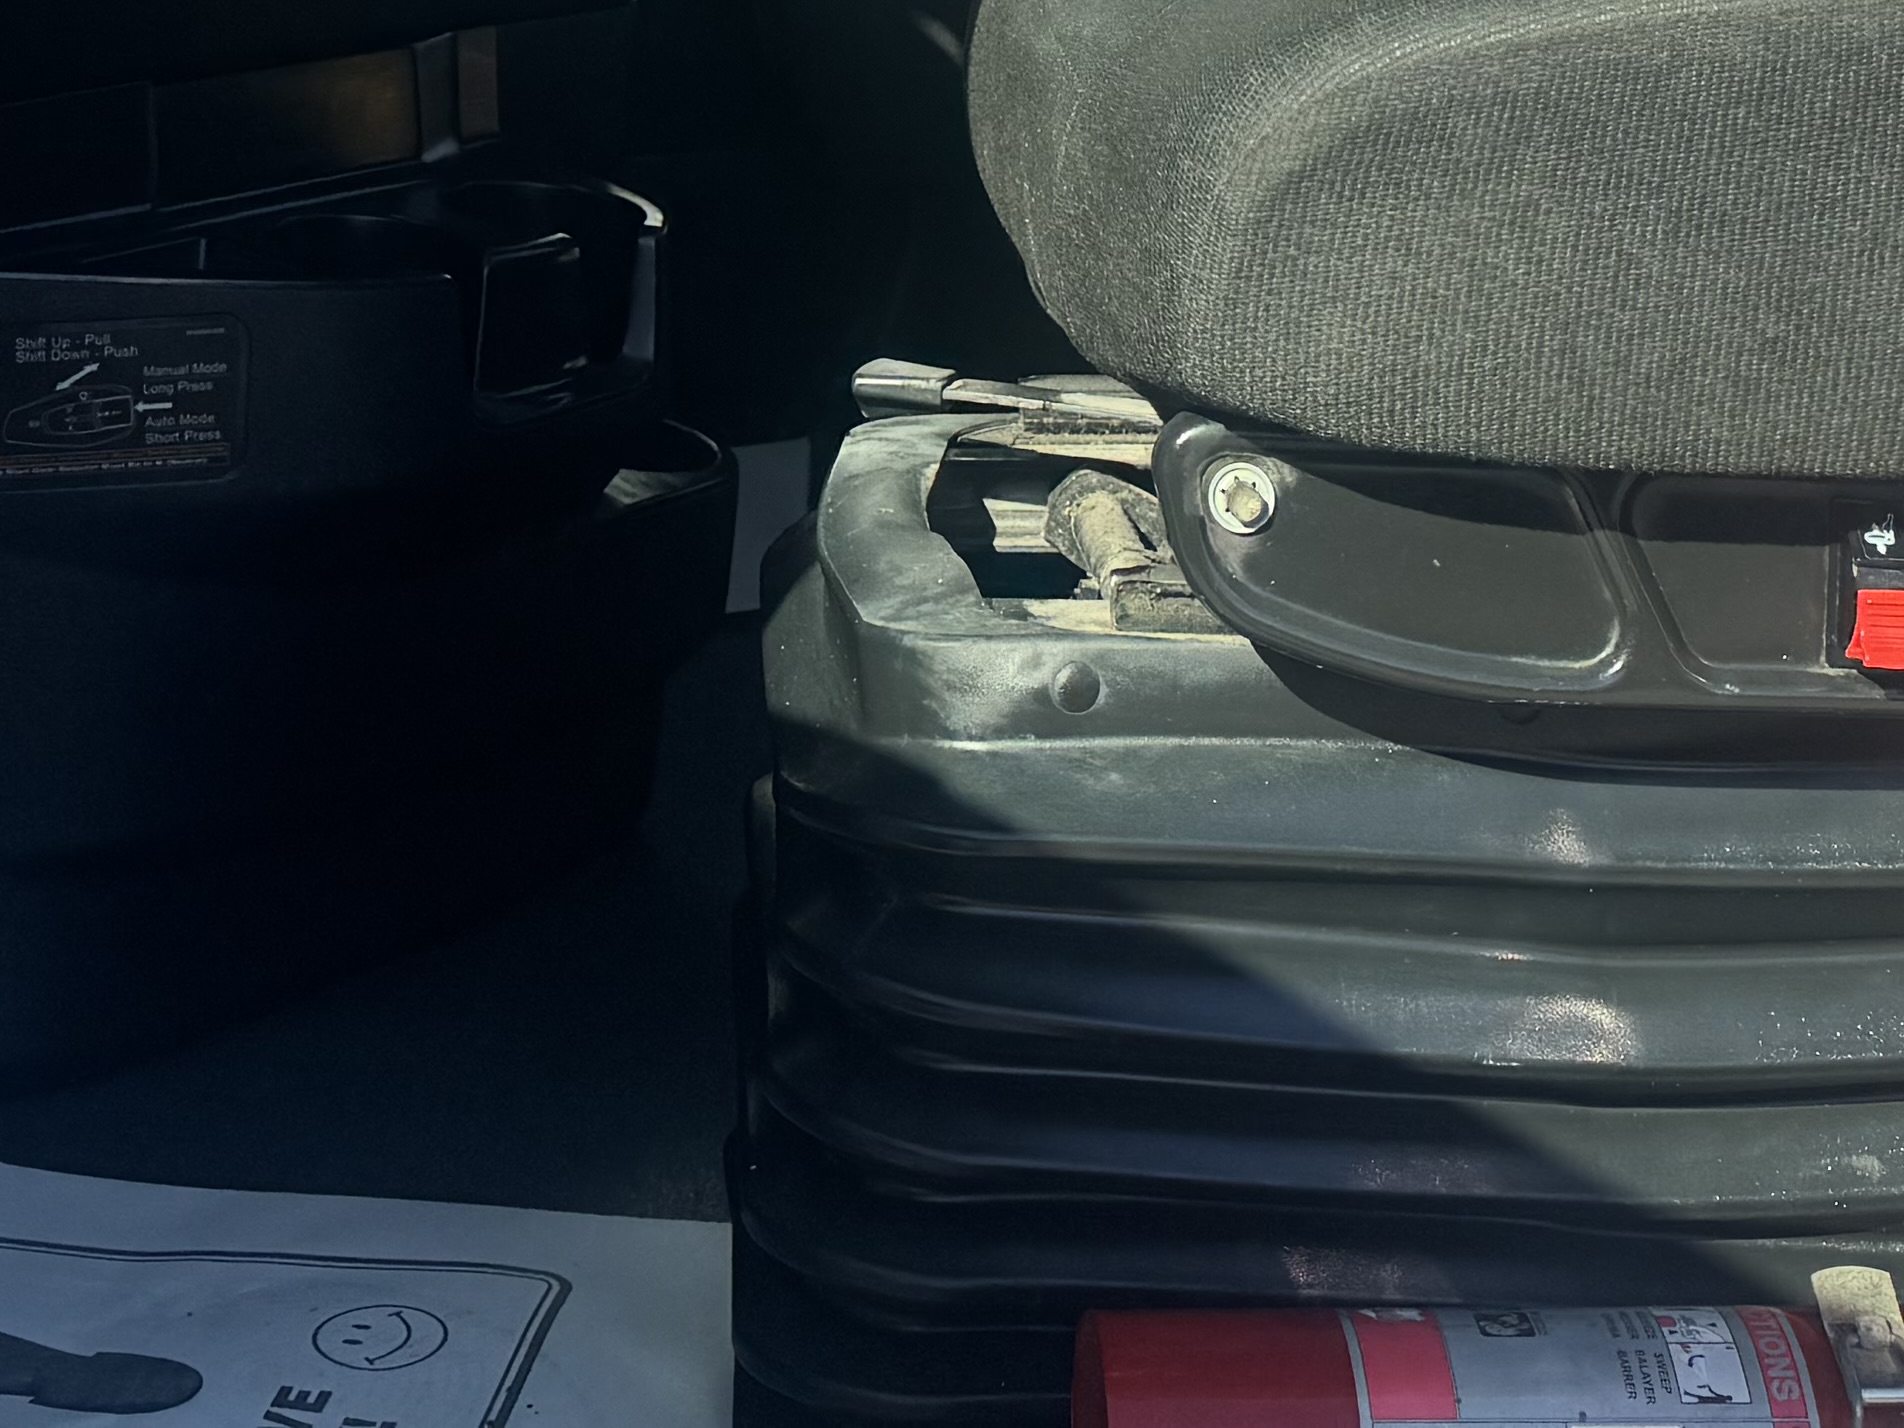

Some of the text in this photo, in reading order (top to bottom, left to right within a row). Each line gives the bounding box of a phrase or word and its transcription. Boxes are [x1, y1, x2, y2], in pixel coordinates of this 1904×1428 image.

[15, 333, 112, 350] Shift Up Pull
[15, 350, 46, 364] Shift
[104, 345, 139, 358] Push
[1616, 1349, 1638, 1401] BARRER
[1634, 1349, 1657, 1405] BALAYER
[1653, 1351, 1672, 1395] SWEEP
